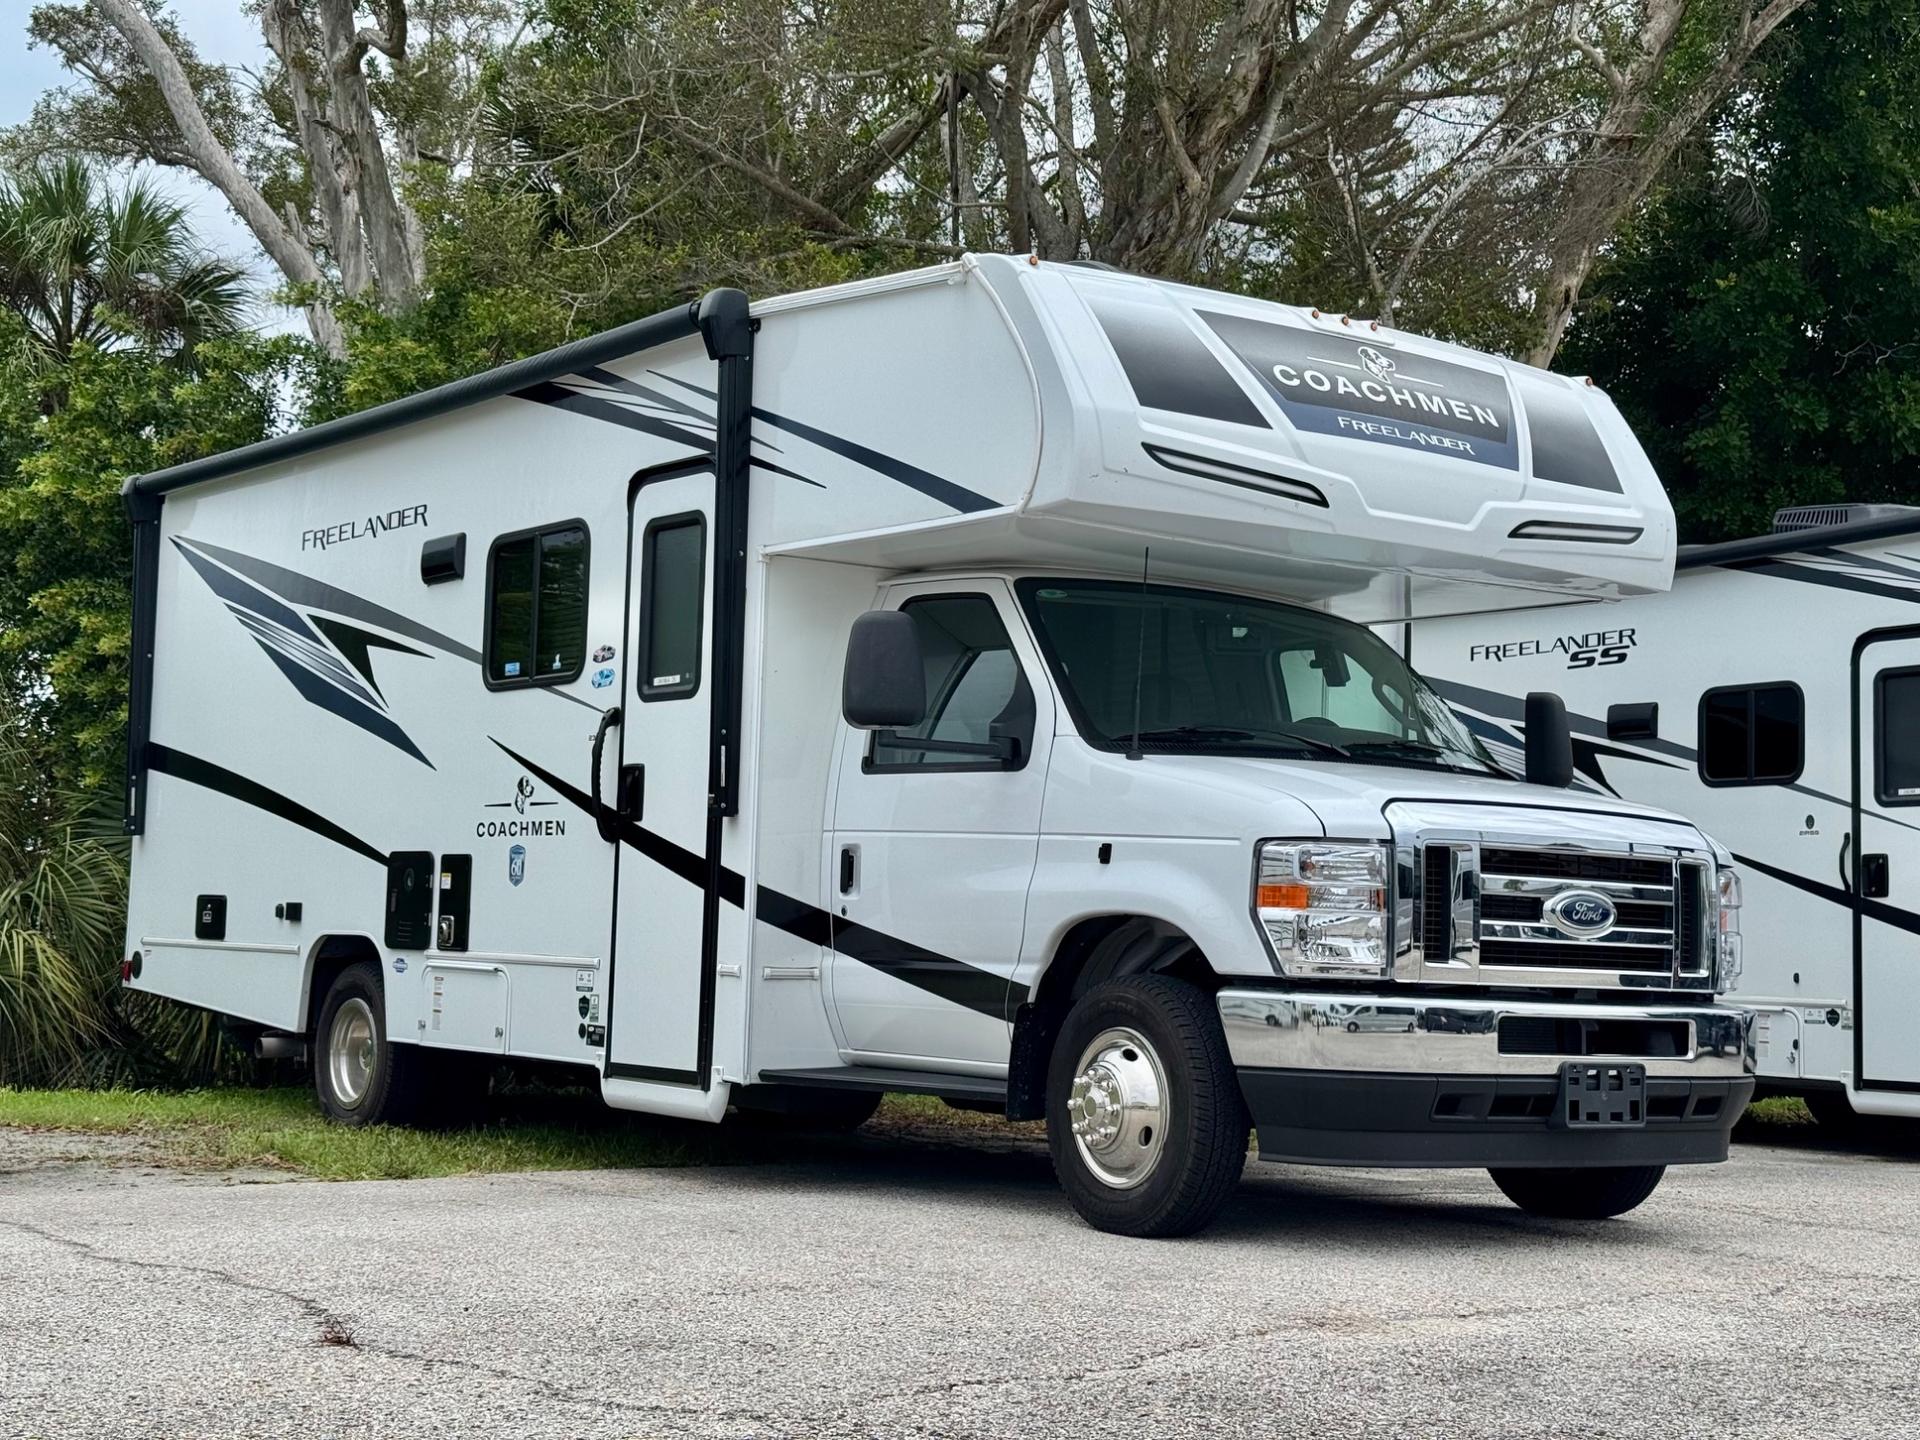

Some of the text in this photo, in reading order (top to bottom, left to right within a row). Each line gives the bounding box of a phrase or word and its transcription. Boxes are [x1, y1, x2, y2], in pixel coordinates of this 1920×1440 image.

[1272, 364, 1500, 428] COACHMEN
[1337, 416, 1476, 455] FREELANDER
[302, 504, 428, 551] FREELANDER
[1470, 628, 1638, 662] FREELANDER
[1567, 645, 1631, 670] SS
[476, 820, 566, 837] COACHMEN
[1572, 901, 1602, 920] Ford
